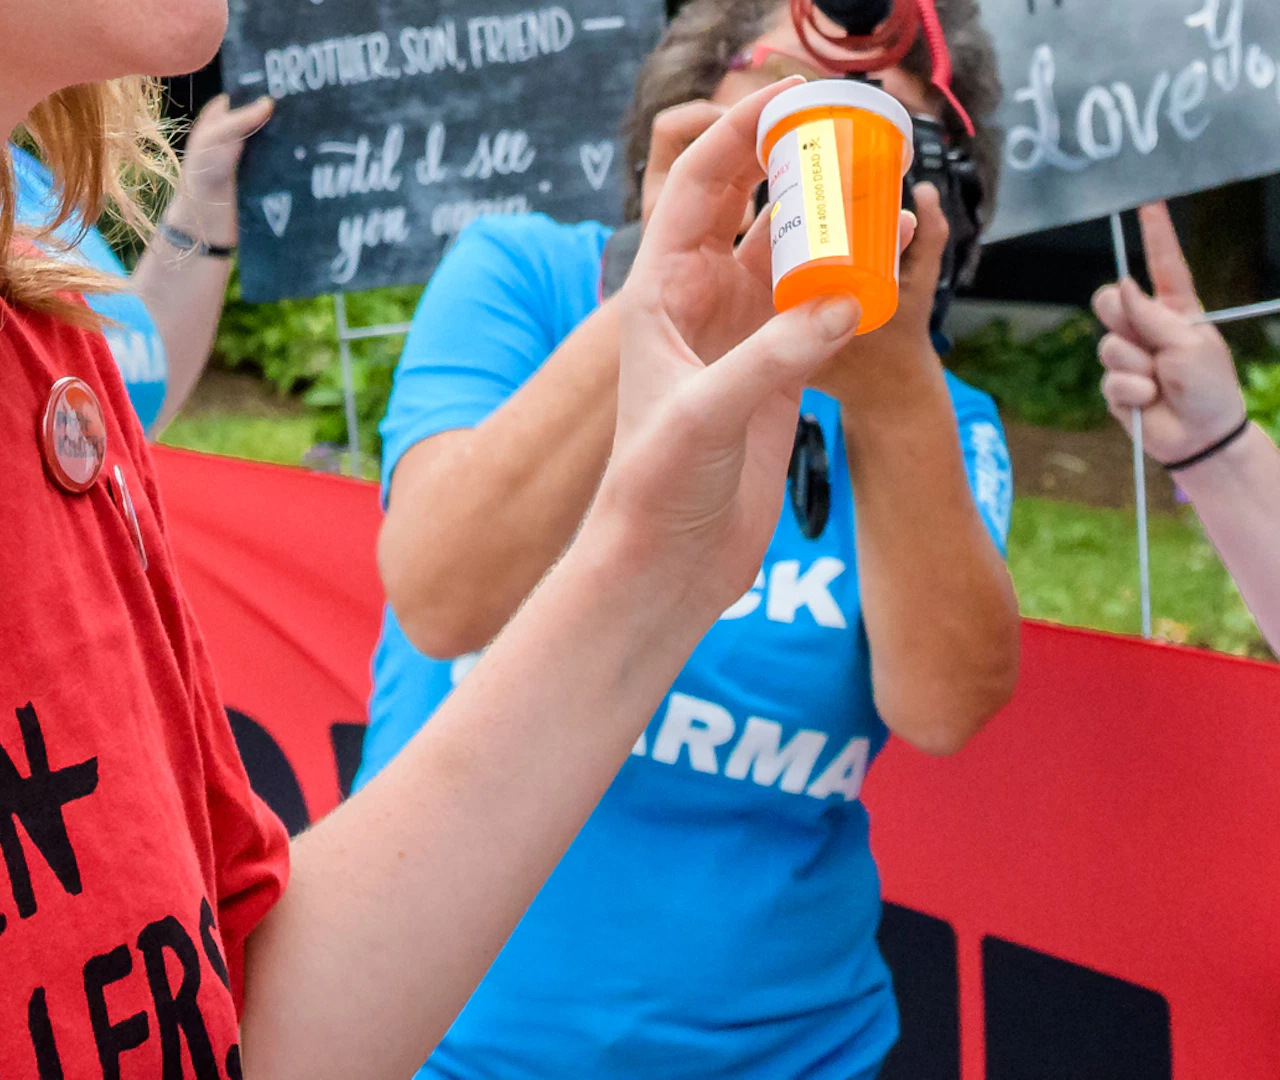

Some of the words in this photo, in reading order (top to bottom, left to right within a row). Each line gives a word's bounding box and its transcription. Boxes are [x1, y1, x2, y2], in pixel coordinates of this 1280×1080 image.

[467, 5, 574, 70] FRIEND
[1005, 44, 1212, 174] Love
[311, 122, 405, 200] until
[460, 128, 538, 180] see
[812, 154, 823, 182] DEAD
[329, 204, 411, 285] you
